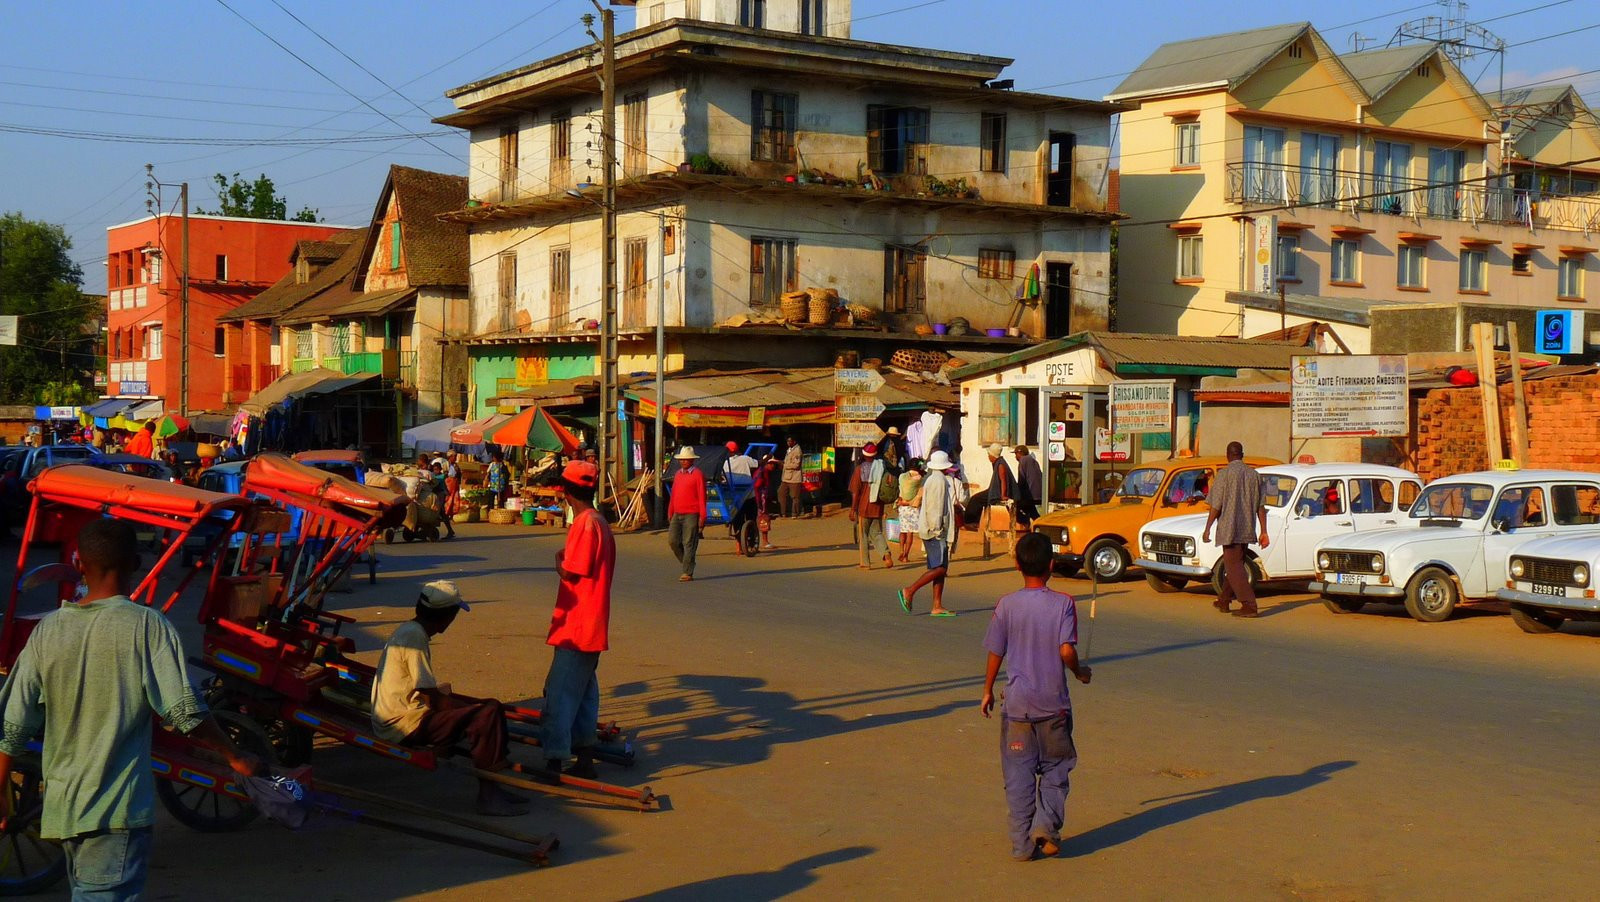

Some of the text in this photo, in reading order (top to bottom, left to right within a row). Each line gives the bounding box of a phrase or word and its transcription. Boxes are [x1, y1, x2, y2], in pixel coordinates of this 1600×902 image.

[1046, 363, 1074, 376] POSTE
[120, 382, 147, 393] PHOTOCOPIE
[1144, 386, 1170, 400] OPTIQUE
[1533, 584, 1564, 596] 3299 FC
